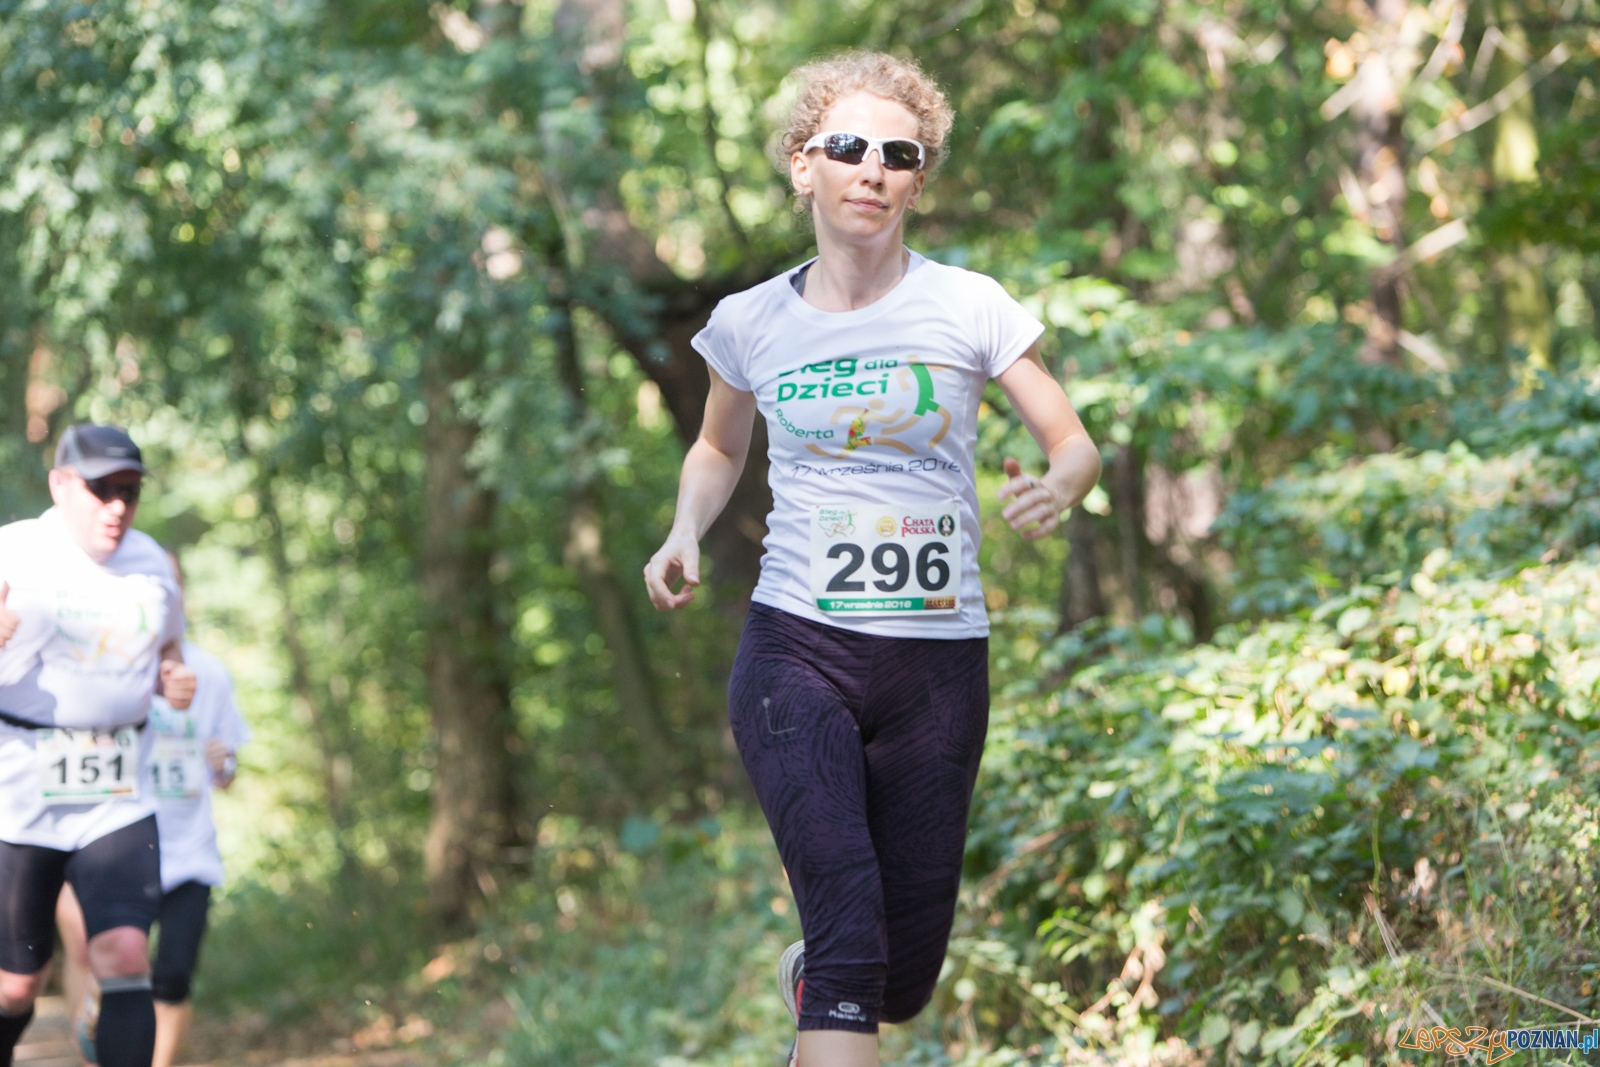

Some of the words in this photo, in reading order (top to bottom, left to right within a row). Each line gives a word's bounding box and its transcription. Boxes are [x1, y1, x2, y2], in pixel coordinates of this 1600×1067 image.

[777, 373, 889, 402] Dzieci
[774, 408, 835, 440] Roberta
[901, 526, 937, 538] POLSKA
[902, 515, 935, 527] CHATA
[825, 541, 950, 593] 296
[829, 600, 843, 610] 17
[50, 753, 123, 785] 151
